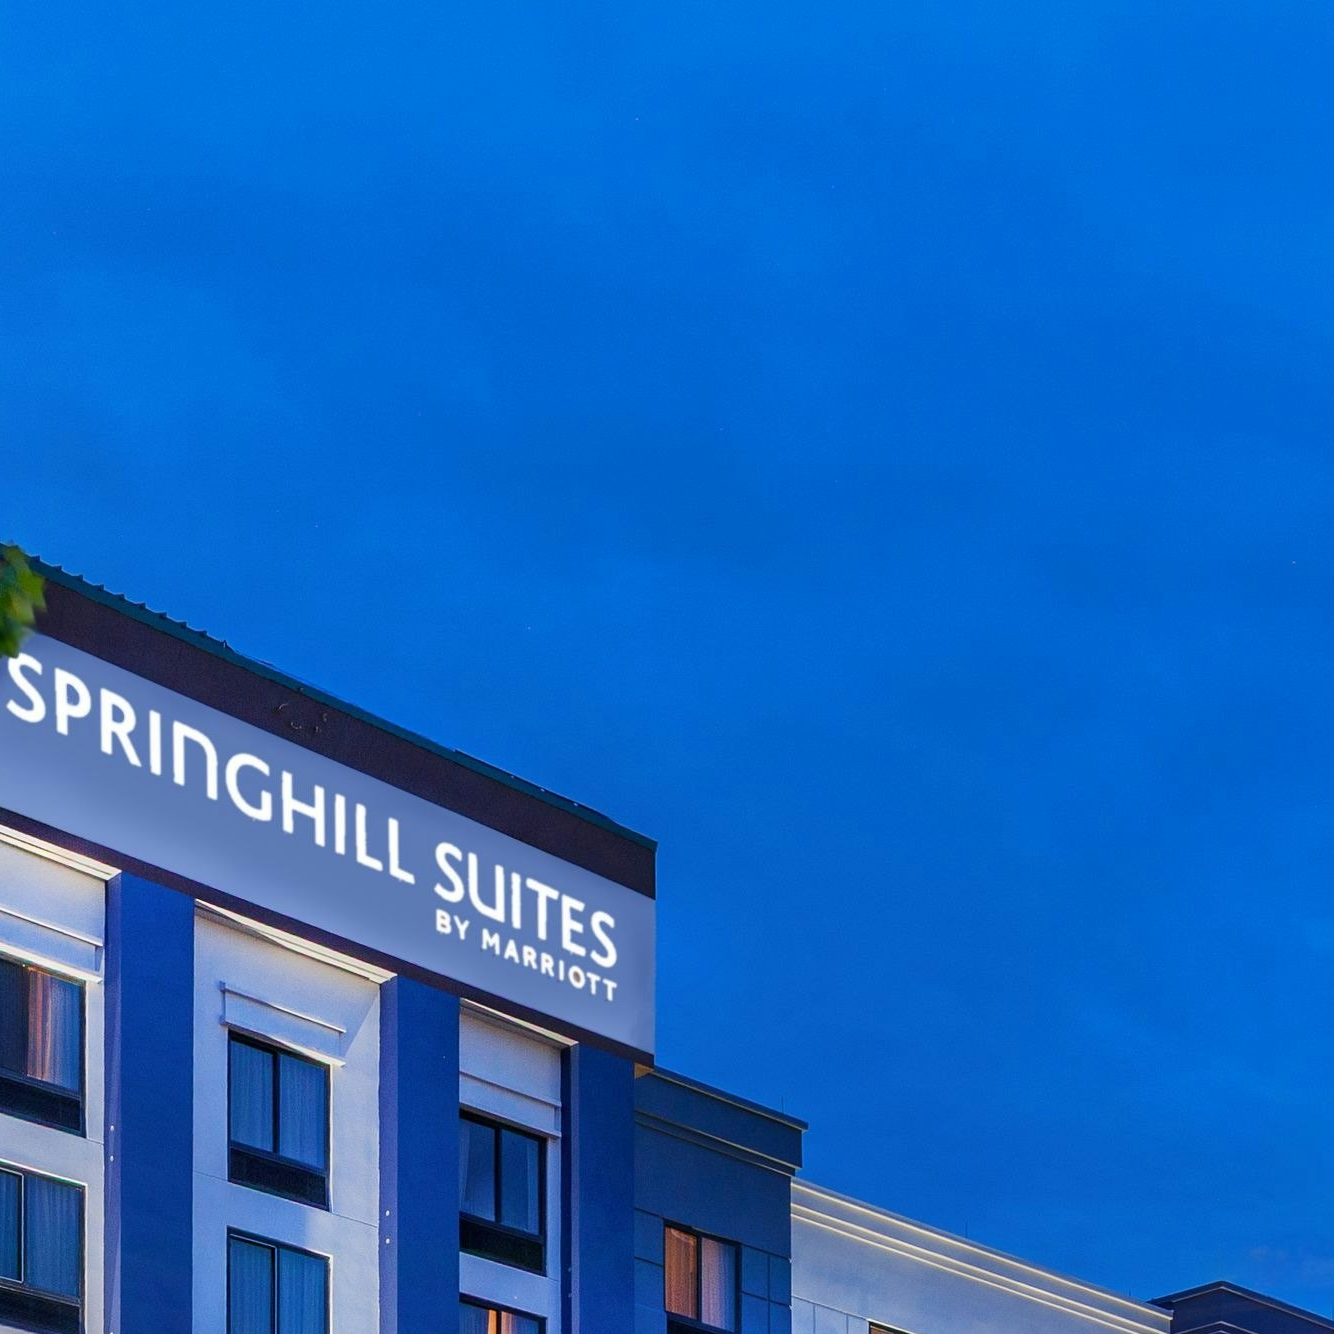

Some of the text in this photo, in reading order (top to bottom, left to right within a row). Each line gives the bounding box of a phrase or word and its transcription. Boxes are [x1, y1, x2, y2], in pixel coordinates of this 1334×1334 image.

[6, 652, 618, 968] SPRINGHILL SUITES
[435, 909, 618, 1001] BY MARRIOTT
